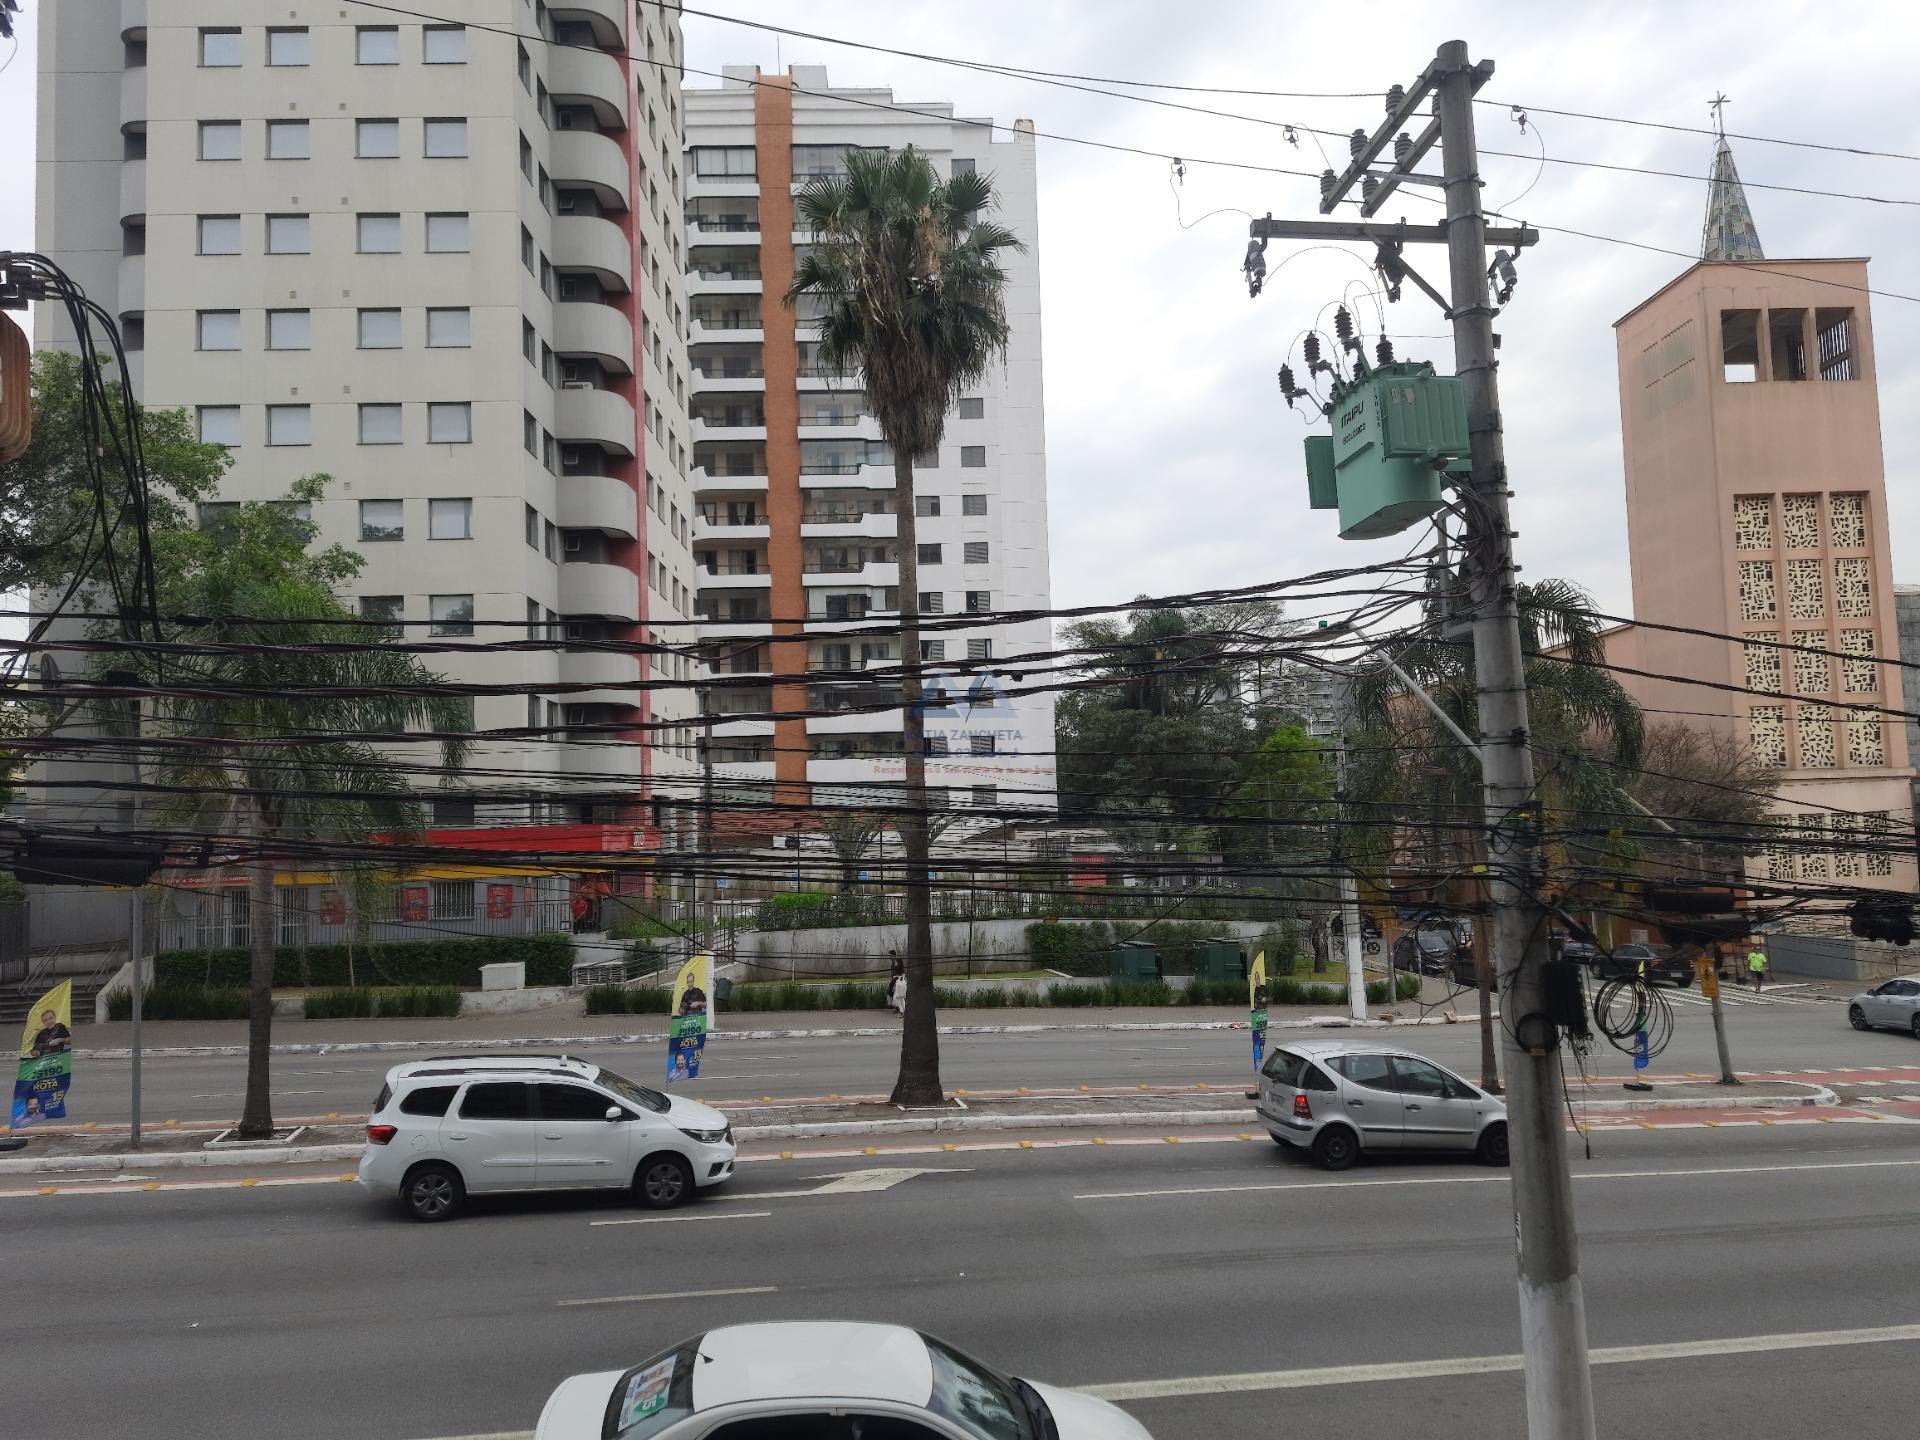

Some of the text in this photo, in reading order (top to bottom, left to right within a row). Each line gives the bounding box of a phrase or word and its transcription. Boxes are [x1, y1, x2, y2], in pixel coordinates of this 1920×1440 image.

[1341, 401, 1364, 428] ITAIPU
[33, 1080, 59, 1091] ROTA
[51, 1090, 65, 1102] 15
